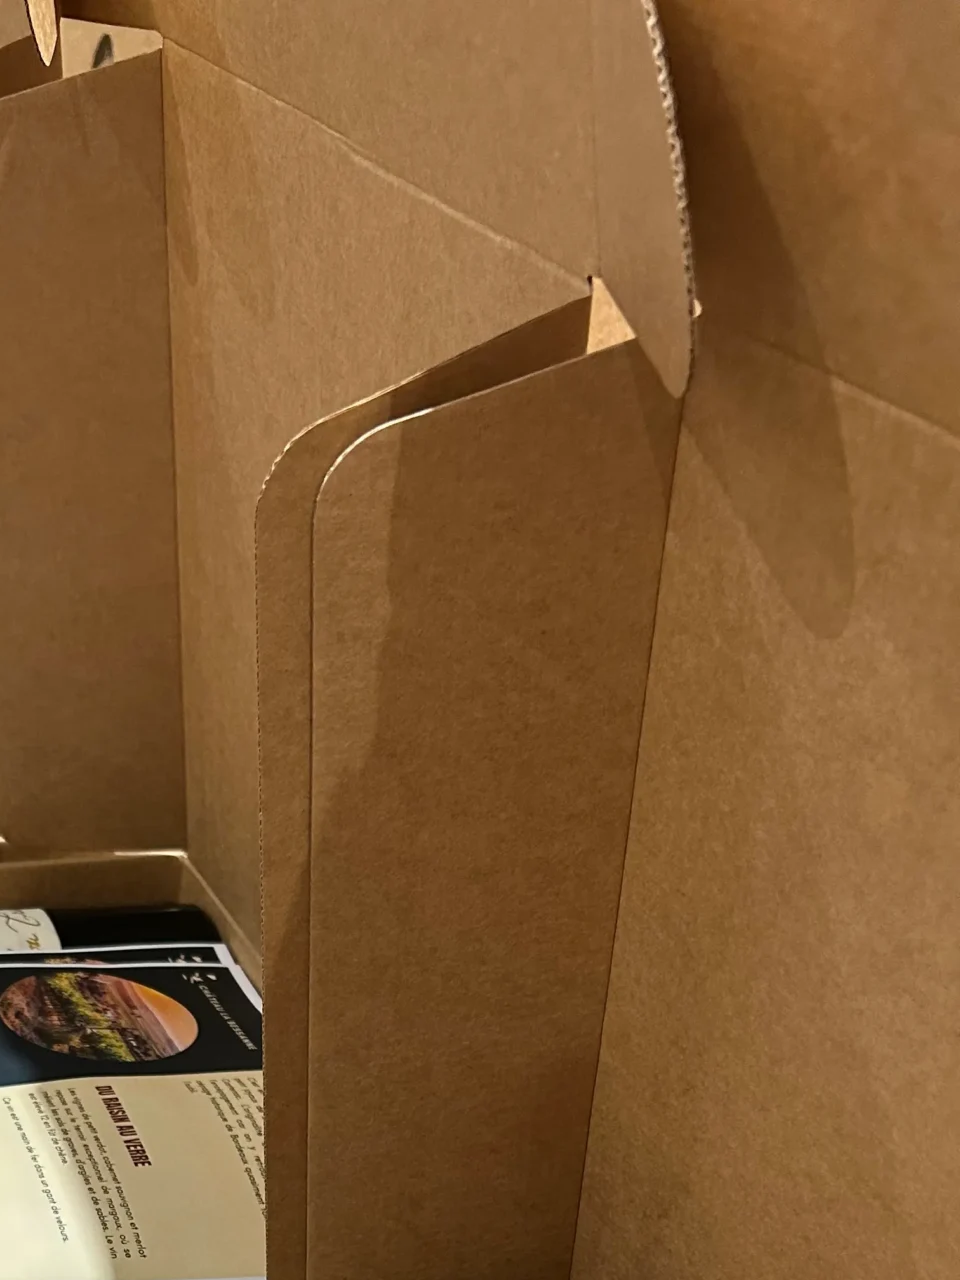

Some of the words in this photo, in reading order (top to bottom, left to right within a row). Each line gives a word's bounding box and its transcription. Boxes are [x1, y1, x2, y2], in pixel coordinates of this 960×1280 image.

[101, 1096, 131, 1124] RAISIN
[115, 1125, 138, 1137] AU
[123, 1137, 153, 1167] VERRE
